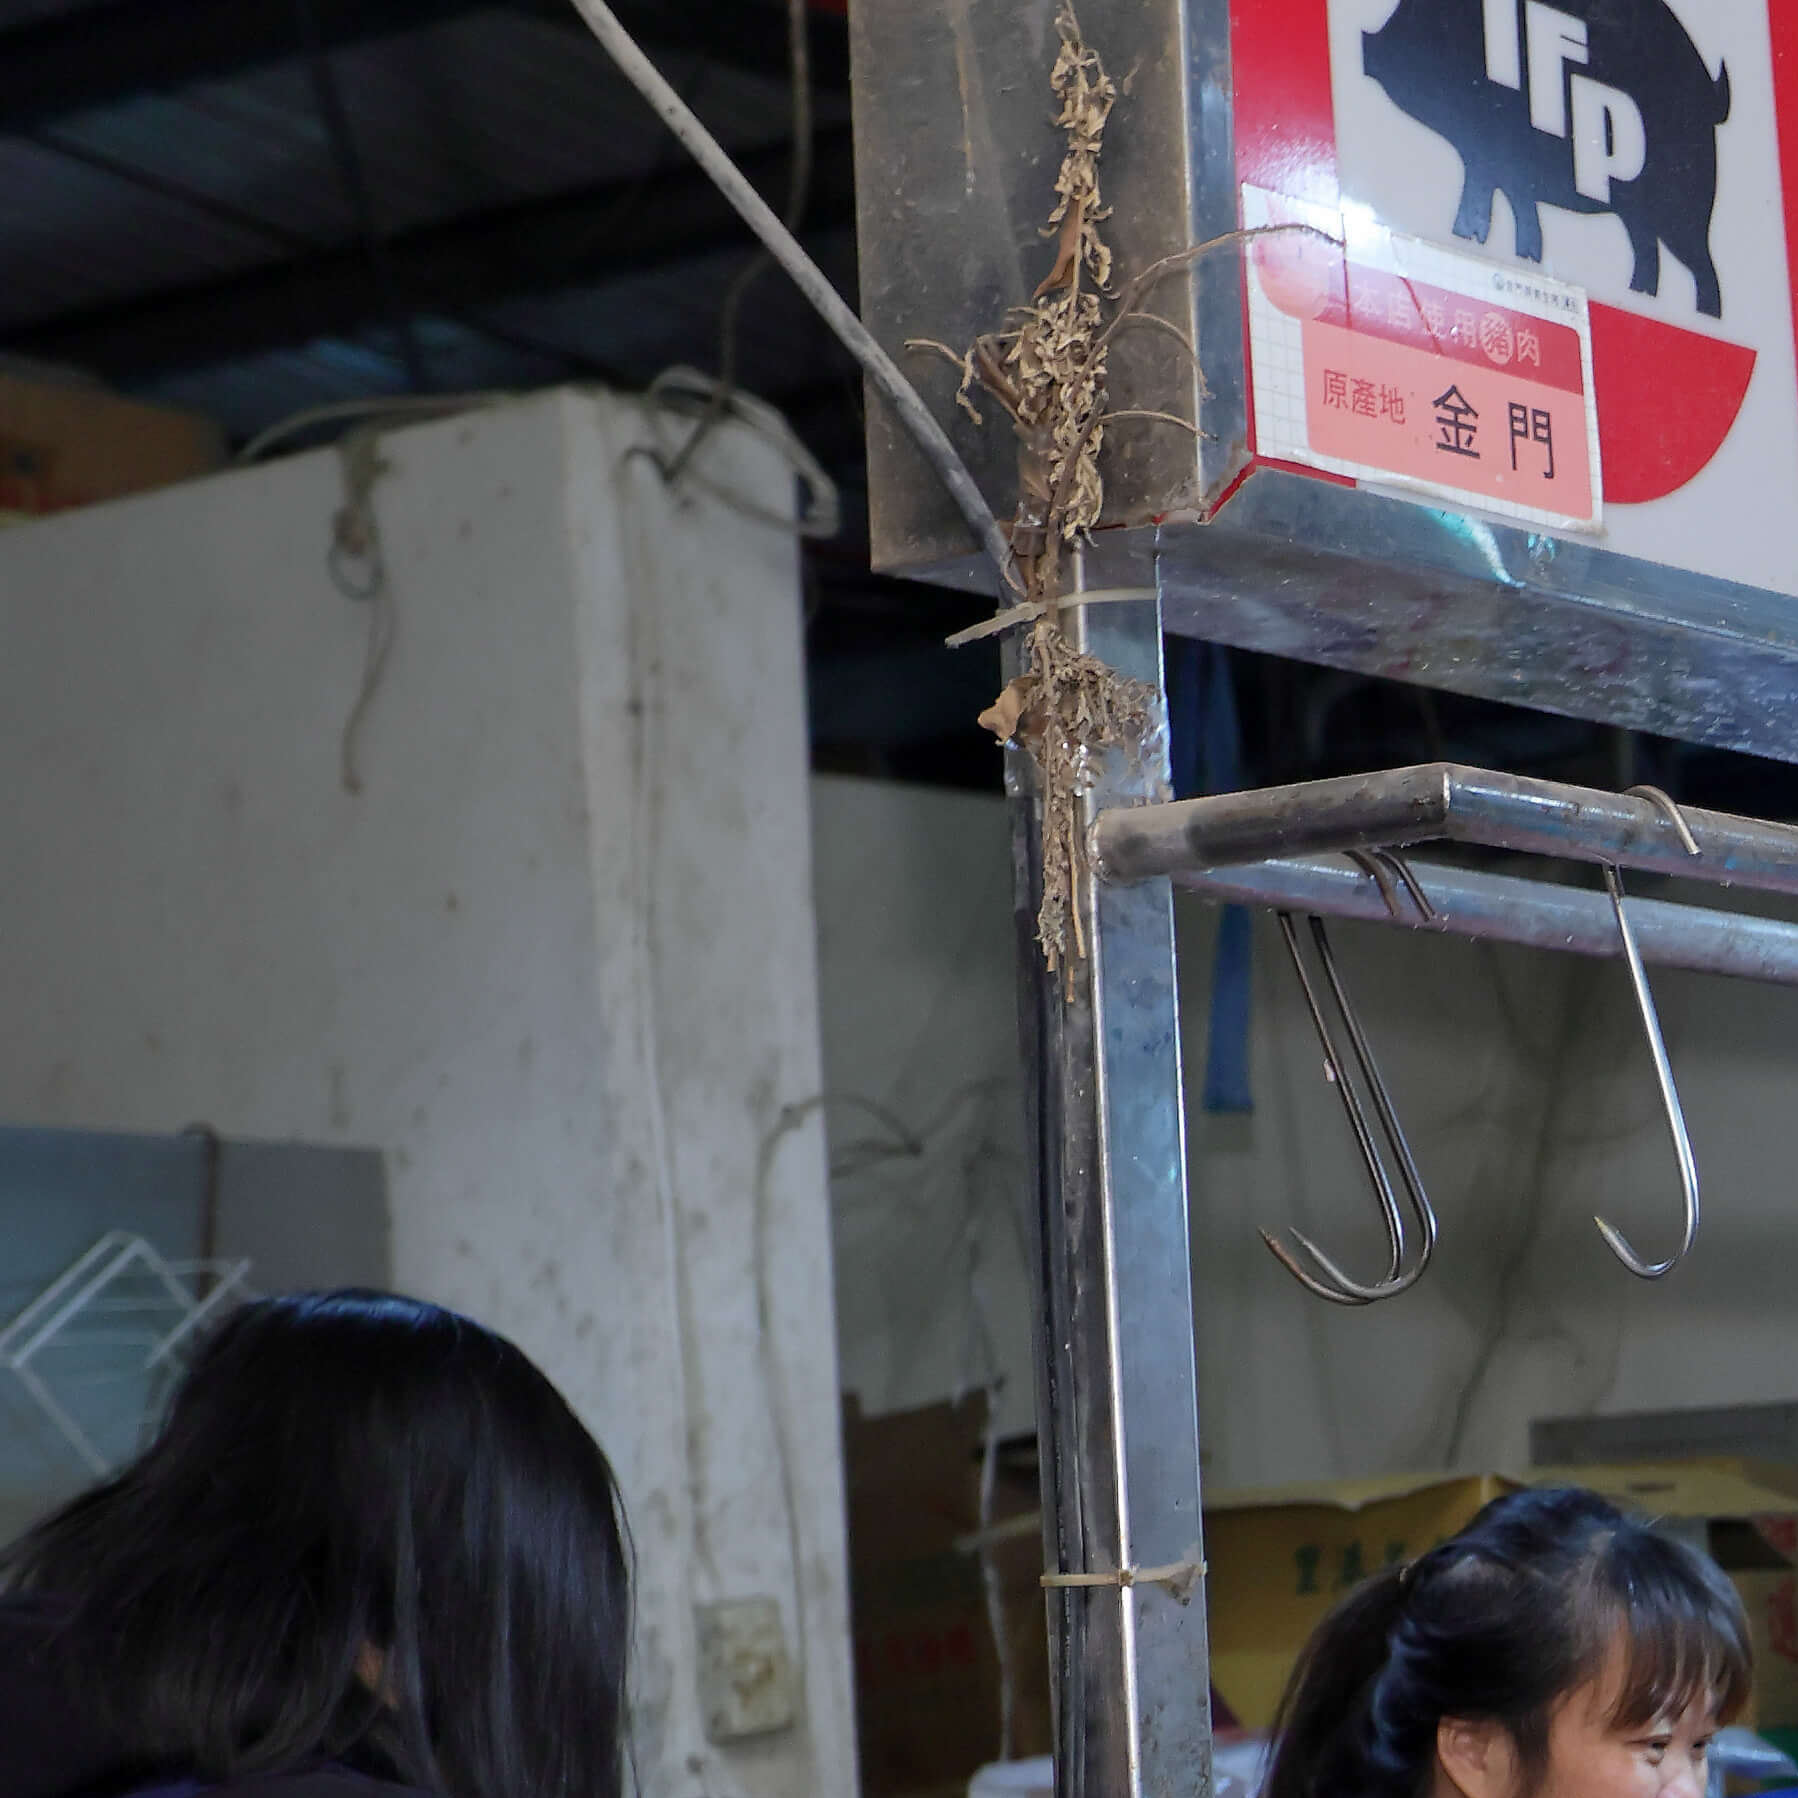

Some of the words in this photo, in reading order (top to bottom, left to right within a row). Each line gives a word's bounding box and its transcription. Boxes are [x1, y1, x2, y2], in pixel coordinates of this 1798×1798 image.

[1322, 368, 1406, 426] 原產地
[1431, 383, 1556, 480] 金門
